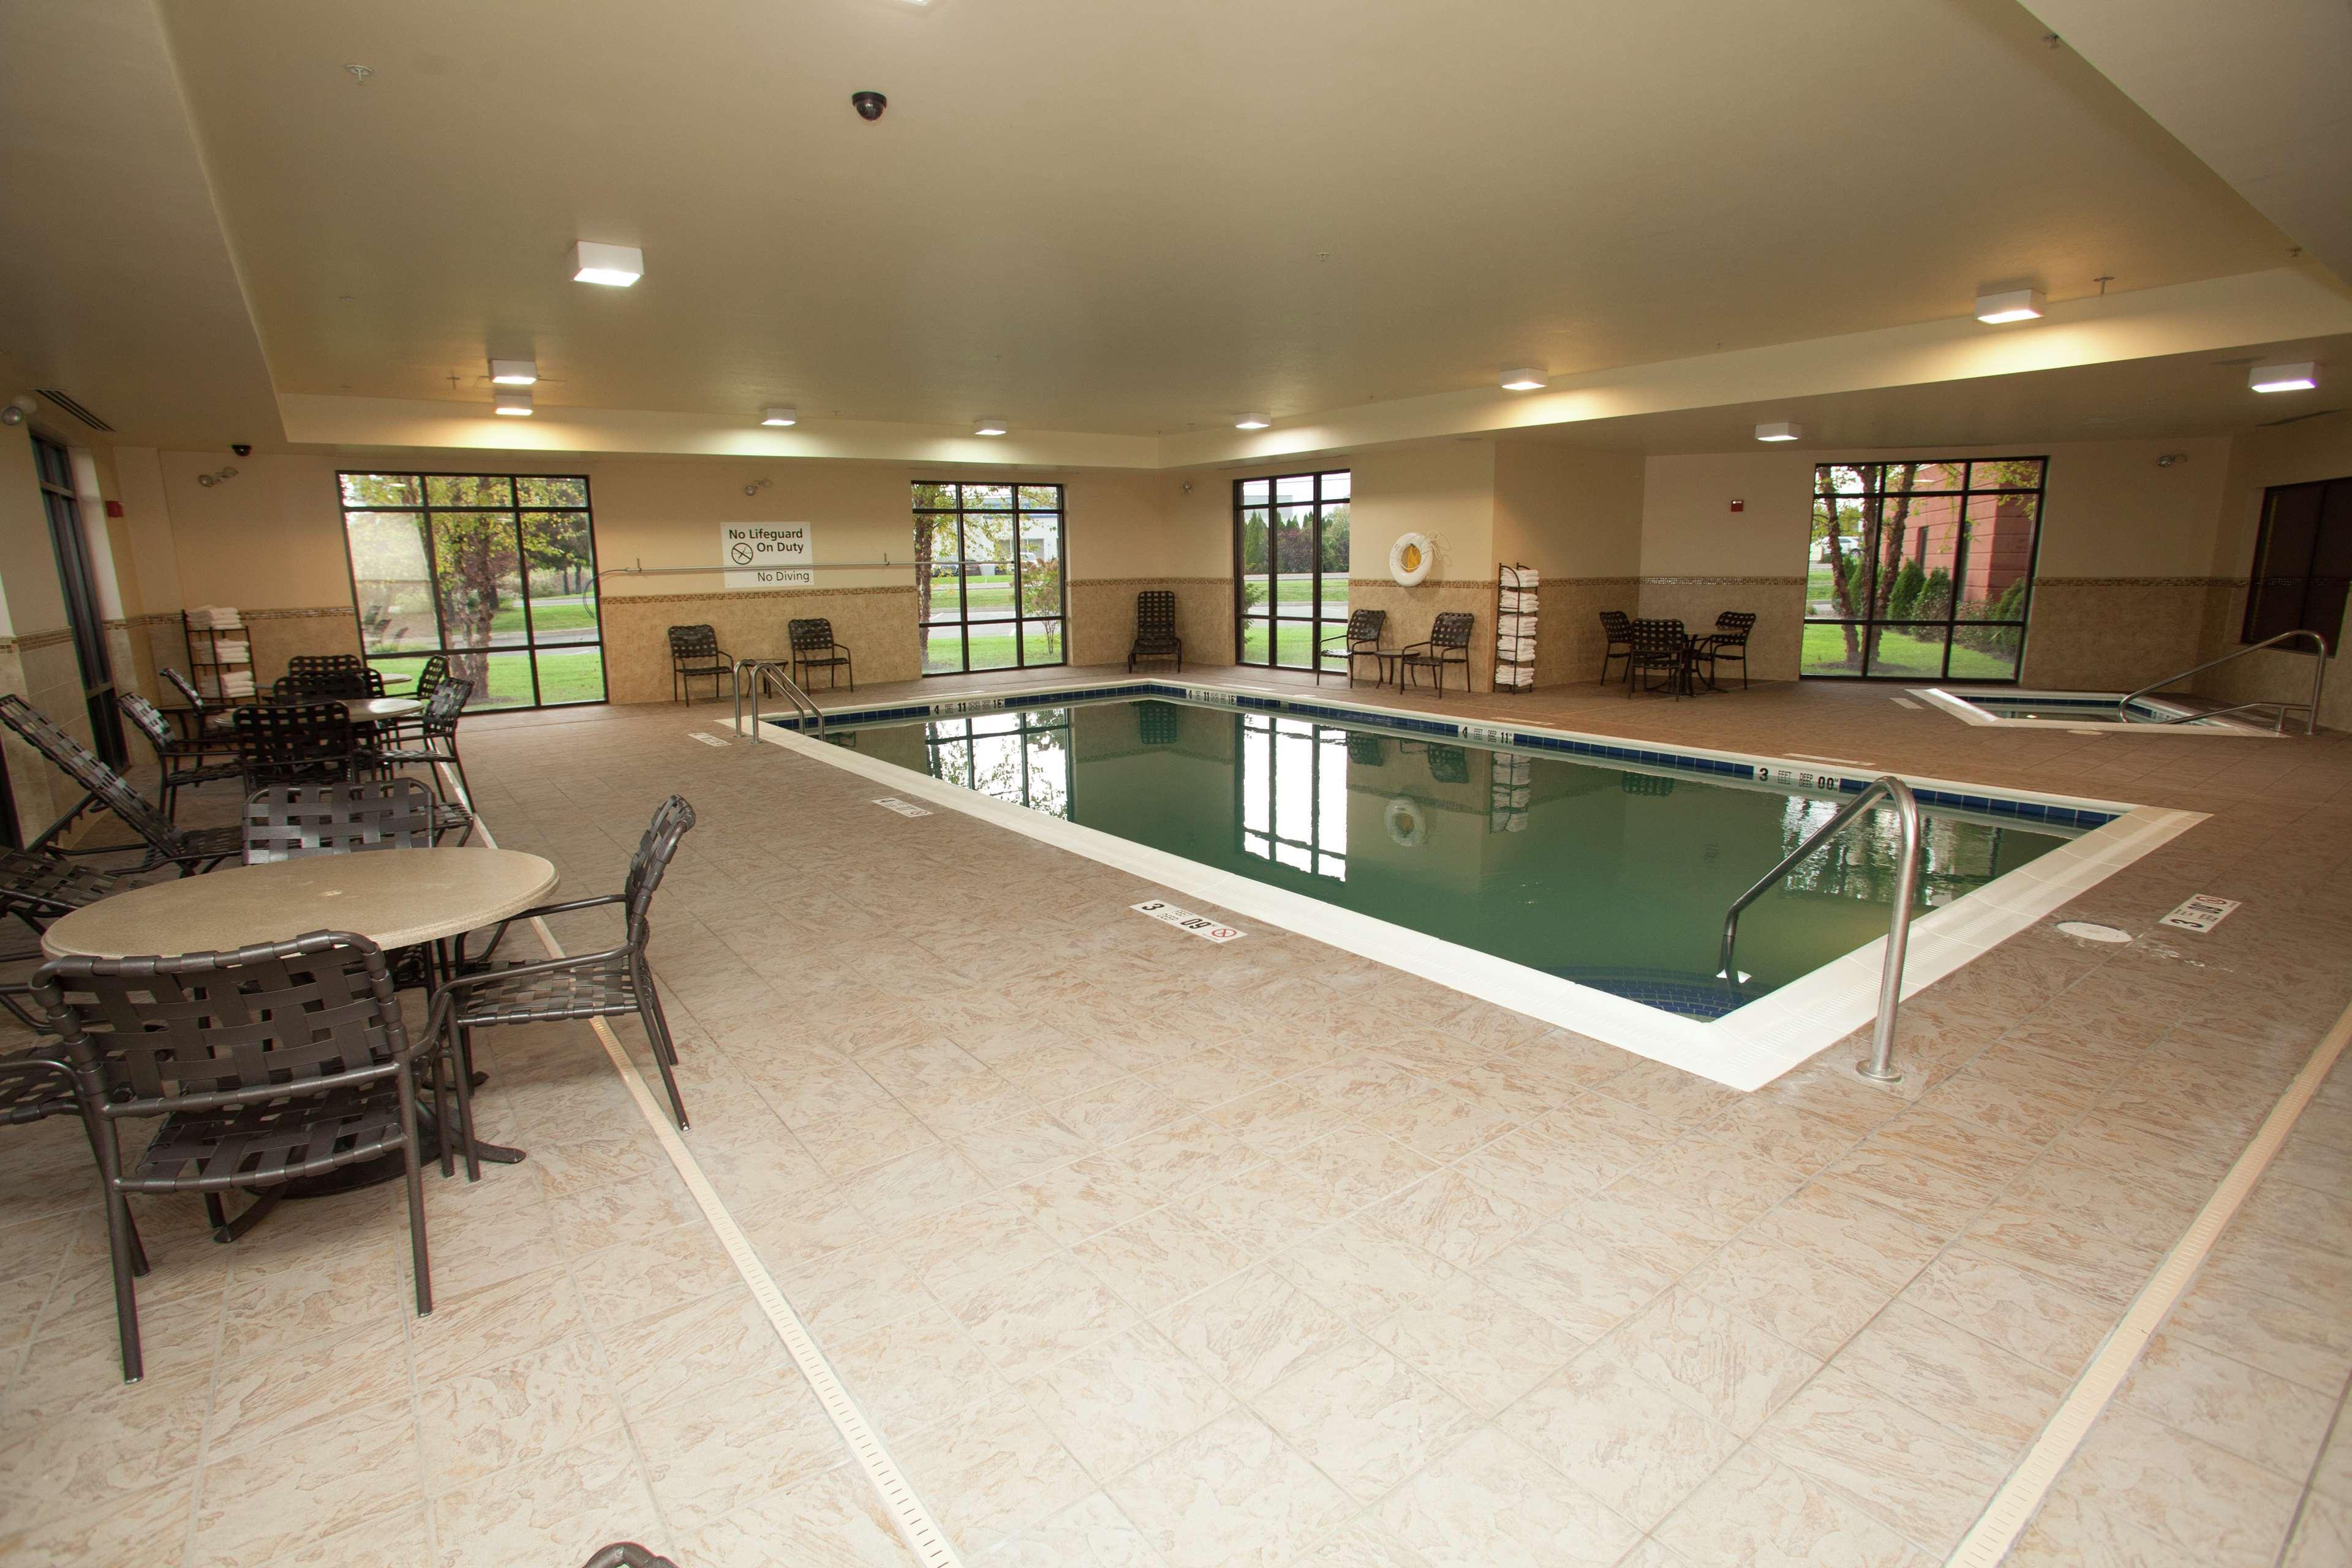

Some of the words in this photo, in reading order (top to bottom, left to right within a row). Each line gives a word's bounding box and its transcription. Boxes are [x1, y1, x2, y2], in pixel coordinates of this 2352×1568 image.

[729, 529, 745, 540] No
[749, 528, 803, 541] Lifeguard
[756, 542, 774, 552] On
[777, 542, 804, 554] Duty
[758, 572, 772, 582] No
[776, 571, 810, 582] Diving
[1759, 767, 1769, 782] 3
[2169, 919, 2204, 928] 3
